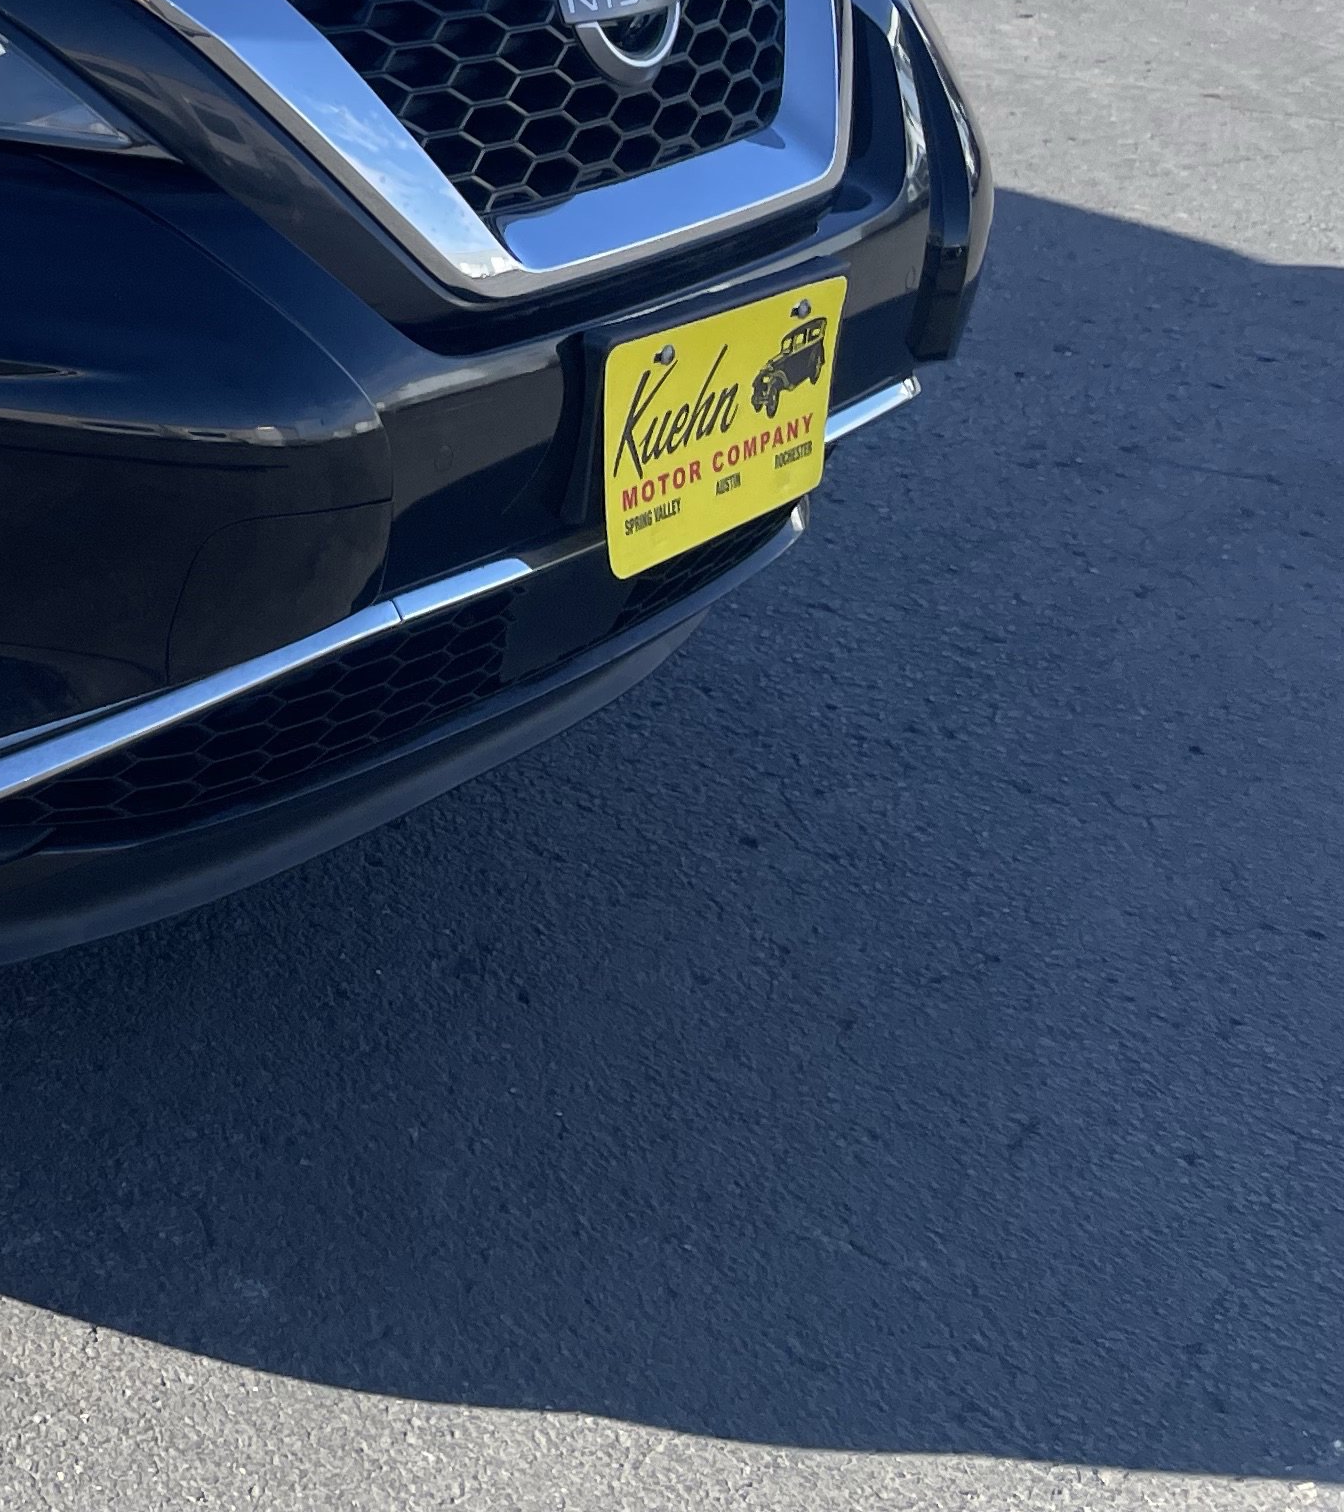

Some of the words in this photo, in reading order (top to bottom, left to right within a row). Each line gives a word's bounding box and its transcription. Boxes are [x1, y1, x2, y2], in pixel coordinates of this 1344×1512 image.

[613, 343, 740, 480] Kuehn
[621, 459, 703, 512] MOTOR
[711, 412, 814, 474] COMPANY
[624, 507, 653, 536] SPRING
[653, 496, 682, 524] VALLEY
